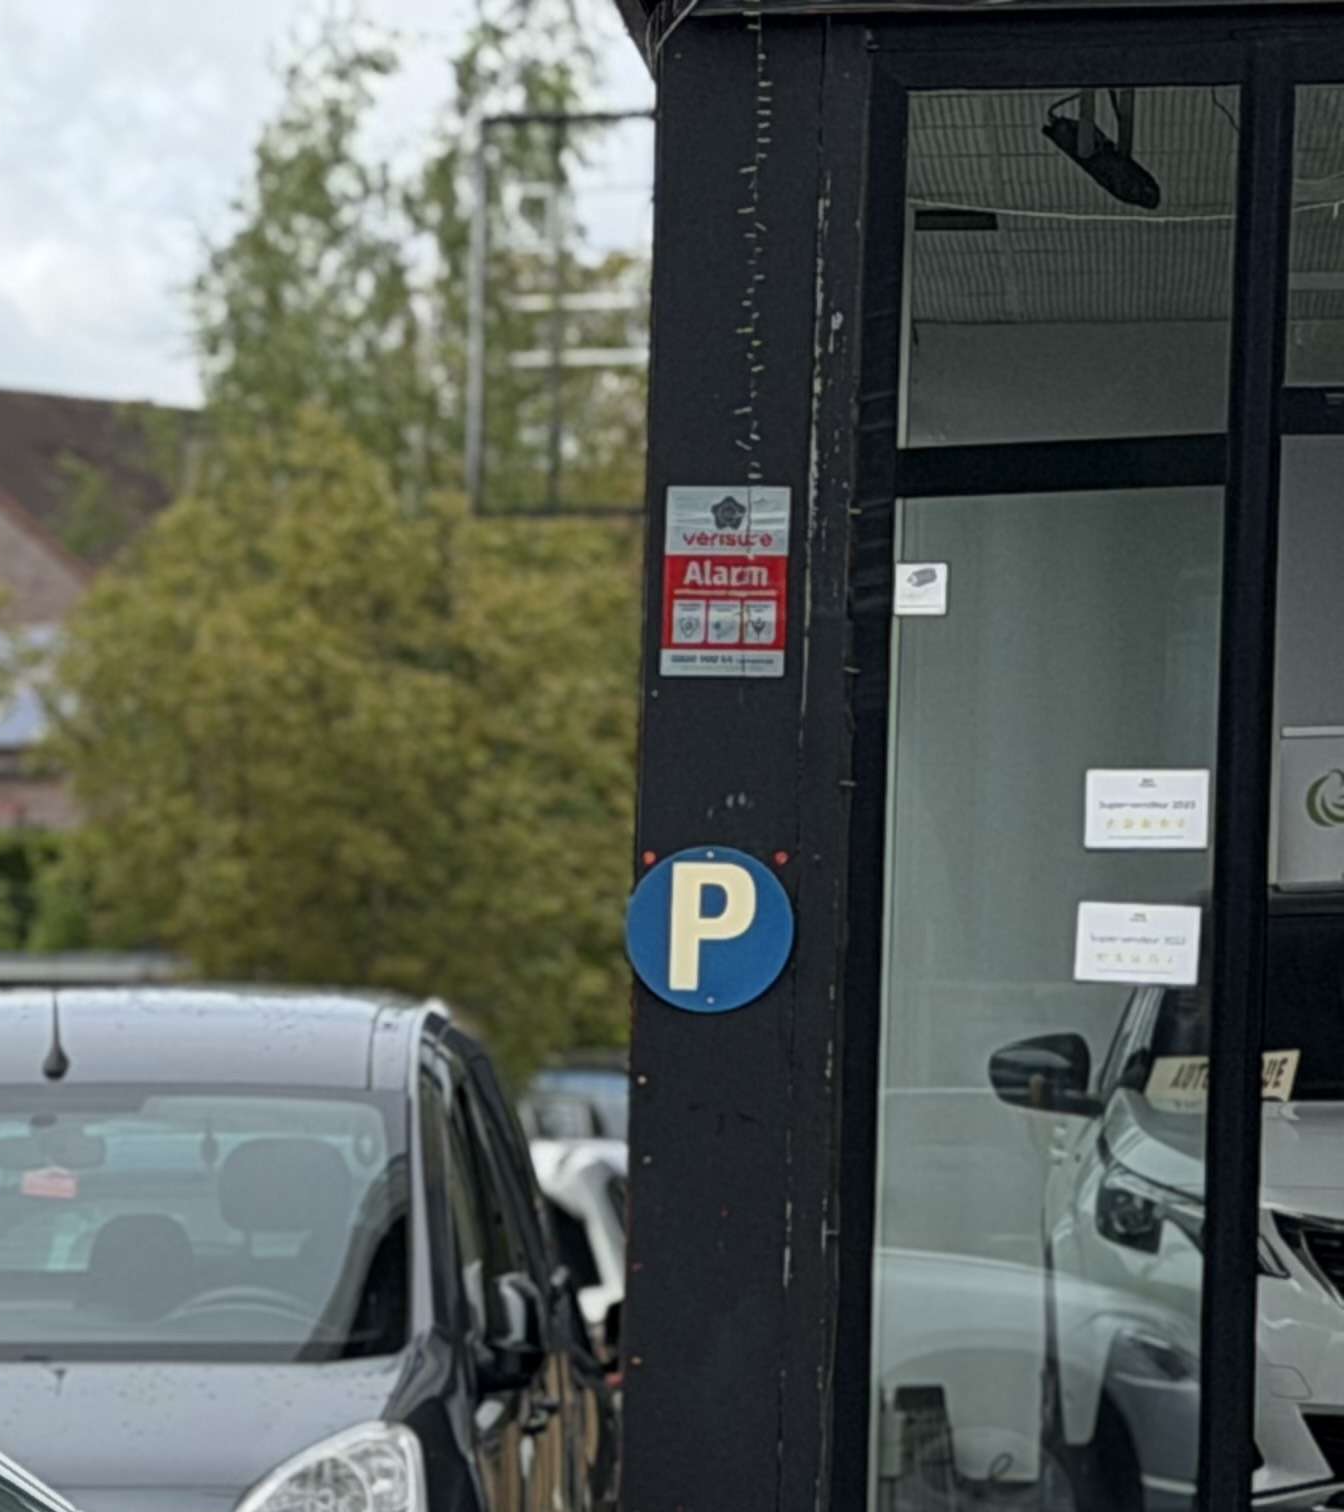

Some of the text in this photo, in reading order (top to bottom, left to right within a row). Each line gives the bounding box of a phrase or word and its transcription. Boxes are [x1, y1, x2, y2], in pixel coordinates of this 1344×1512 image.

[683, 531, 773, 547] verisure
[683, 559, 769, 586] Alarm
[669, 861, 756, 991] P
